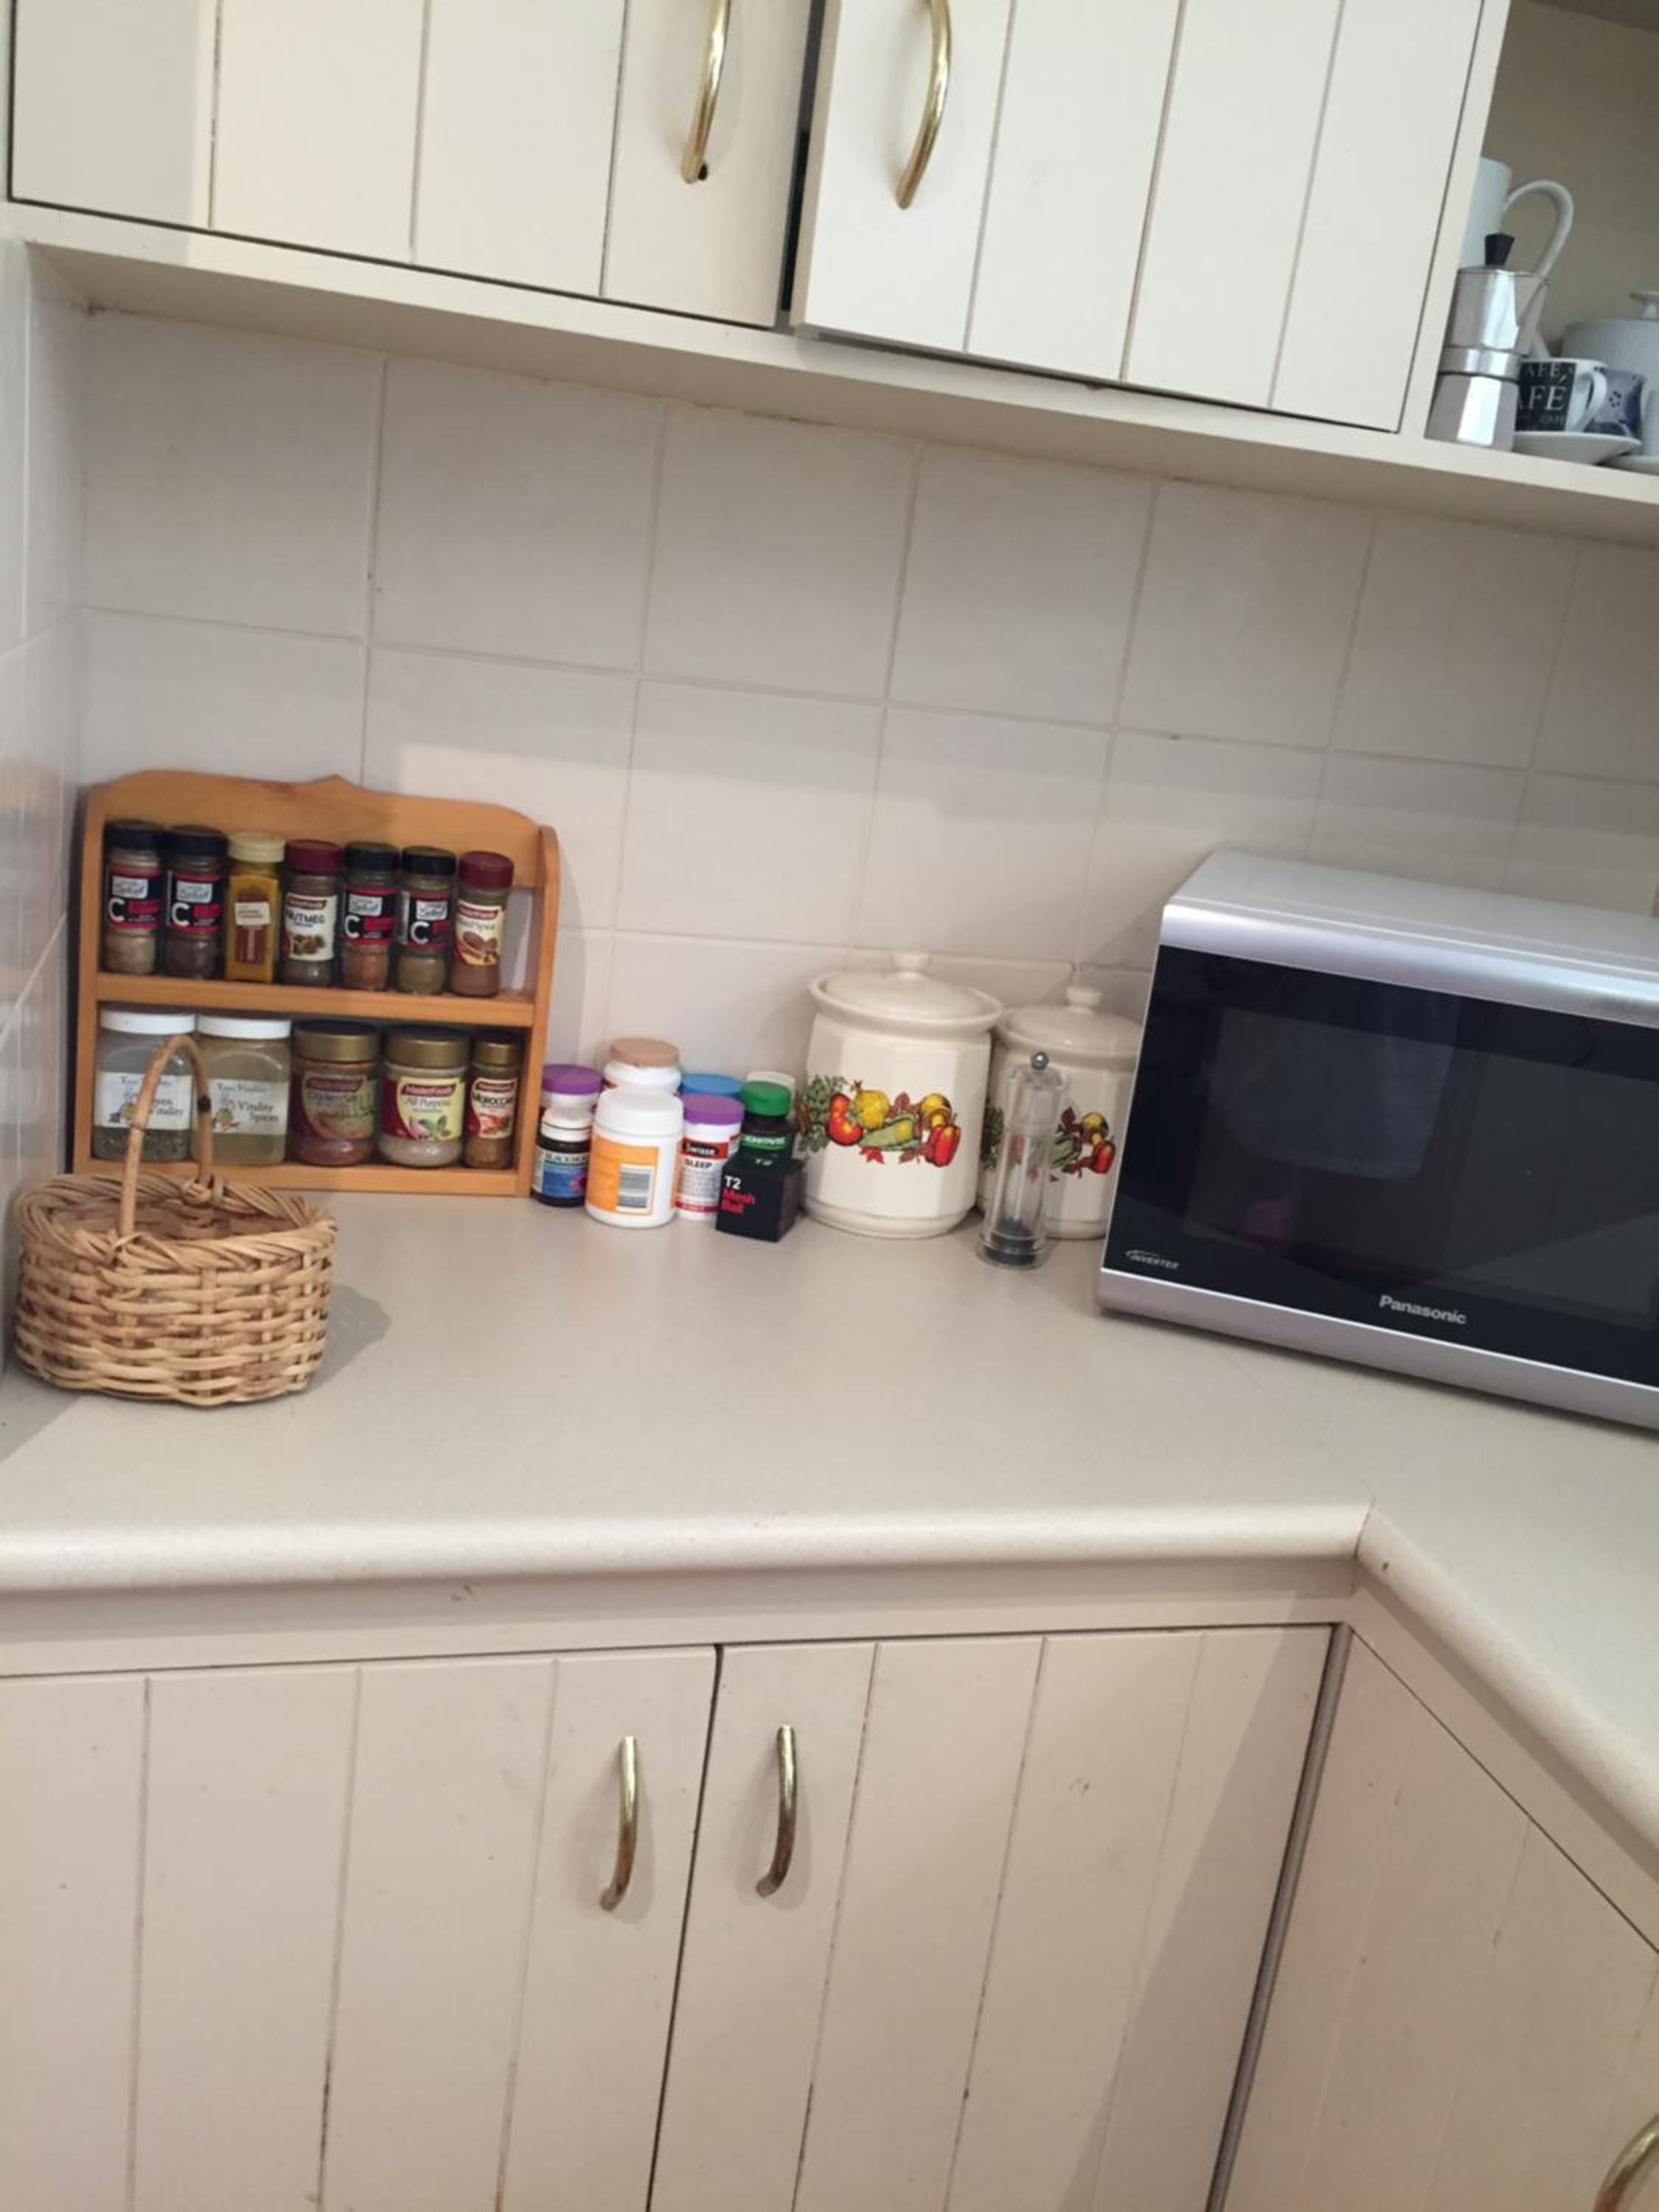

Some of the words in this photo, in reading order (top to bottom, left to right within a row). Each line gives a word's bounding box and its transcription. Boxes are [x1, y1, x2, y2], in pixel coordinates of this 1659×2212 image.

[284, 908, 325, 924] NUTMEG
[684, 1158, 713, 1169] SLEEP
[725, 1175, 742, 1190] T2
[1379, 1294, 1467, 1324] Panasonic
